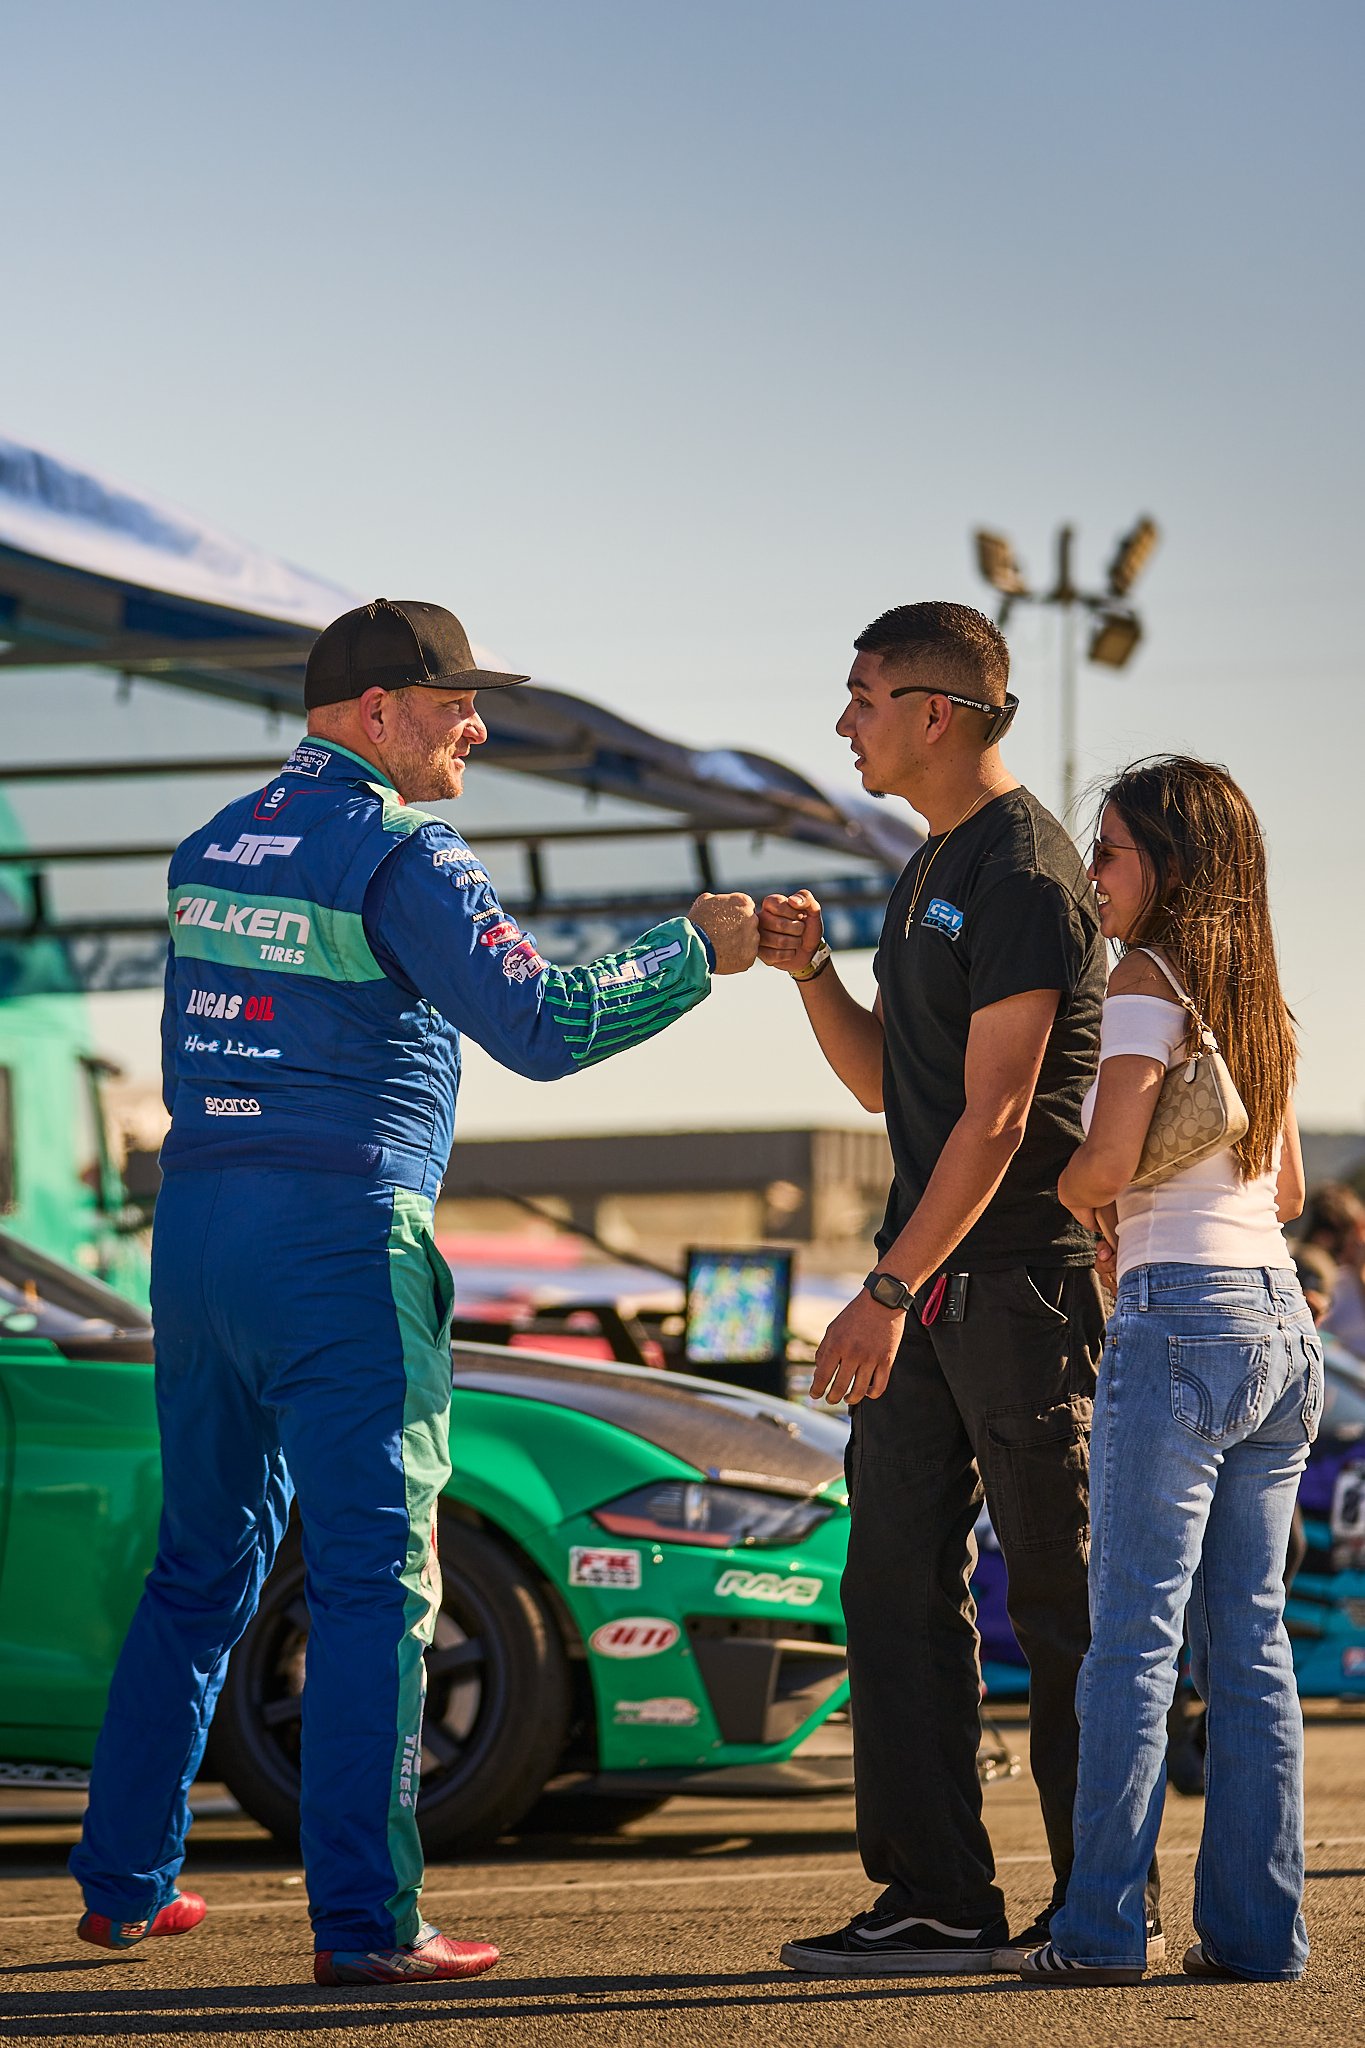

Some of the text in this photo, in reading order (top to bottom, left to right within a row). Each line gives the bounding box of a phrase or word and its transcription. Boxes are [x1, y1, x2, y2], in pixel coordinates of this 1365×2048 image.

[947, 694, 982, 710] CORVETTE
[203, 833, 303, 866] JTP
[174, 896, 310, 945] FALKEN
[259, 944, 305, 965] TIRES
[185, 989, 275, 1021] LUCAS OIL
[184, 1034, 221, 1053] Hot
[204, 1096, 262, 1116] sparco
[399, 1734, 418, 1808] TIRES
